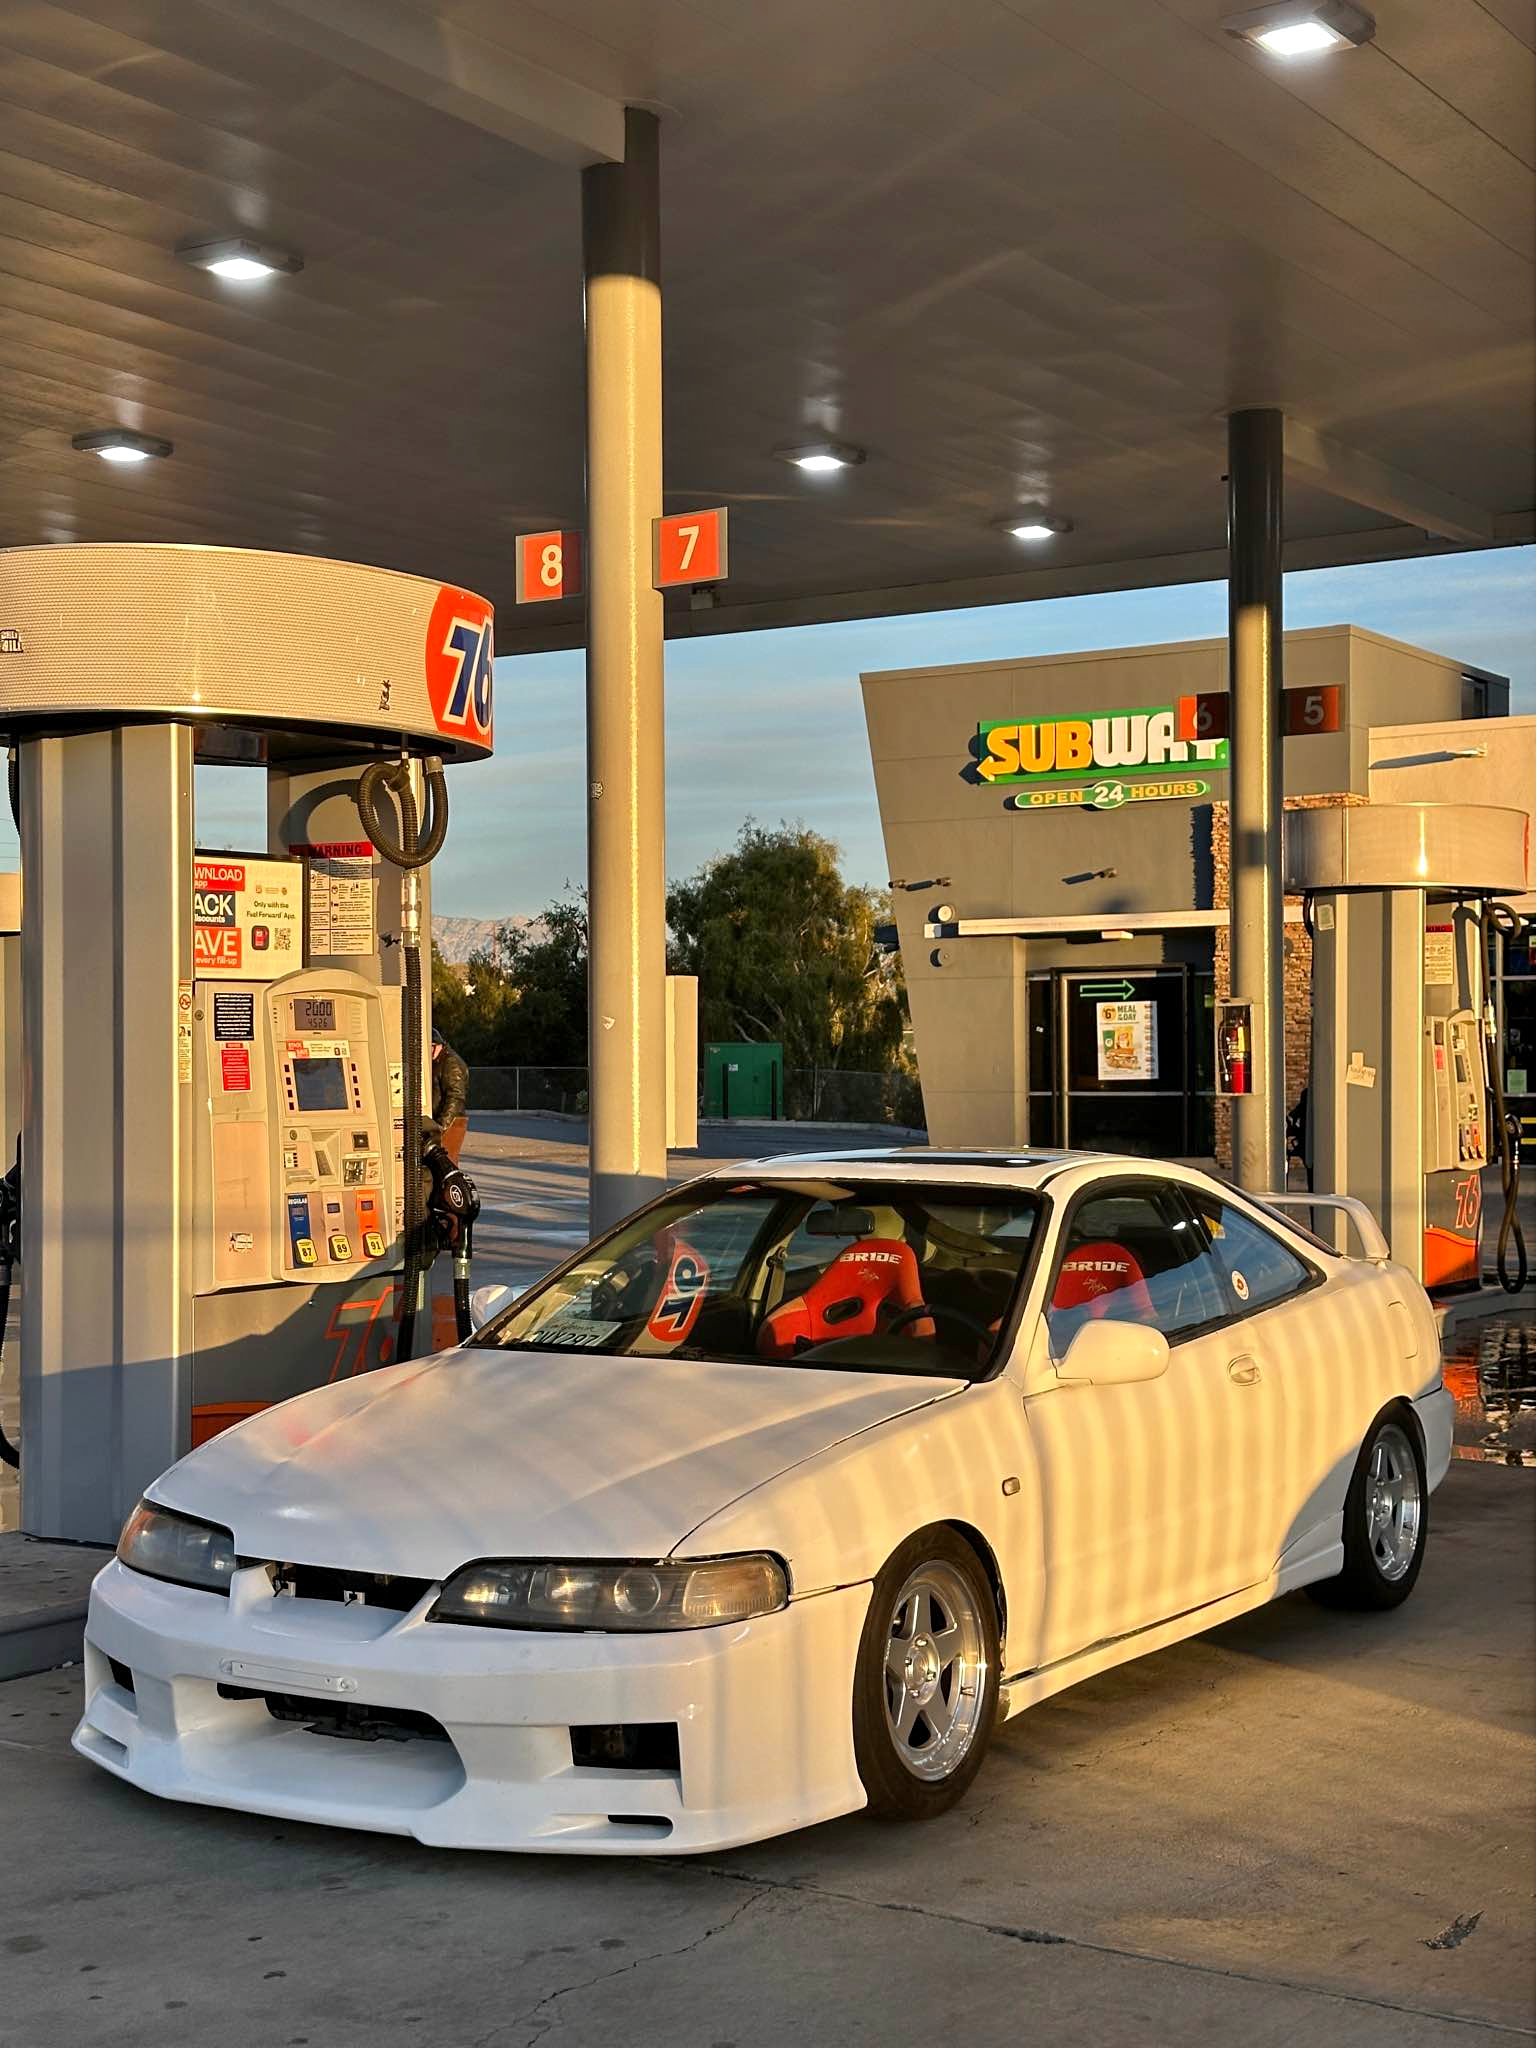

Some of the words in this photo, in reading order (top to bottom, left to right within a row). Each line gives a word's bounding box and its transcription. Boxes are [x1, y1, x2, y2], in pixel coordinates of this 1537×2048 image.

[678, 525, 700, 570] 7
[540, 544, 563, 587] 8
[442, 616, 494, 736] 76
[1192, 702, 1213, 732] 6
[1303, 696, 1325, 726] 5
[1030, 791, 1084, 805] OPEN
[1094, 784, 1124, 803] 24
[1131, 781, 1198, 798] HOURS
[1455, 1174, 1479, 1229] 76
[301, 1247, 312, 1257] 87
[336, 1244, 348, 1253] 89
[371, 1241, 381, 1251] 91
[840, 1252, 903, 1264] BRIDE
[1062, 1261, 1131, 1273] BRIDE
